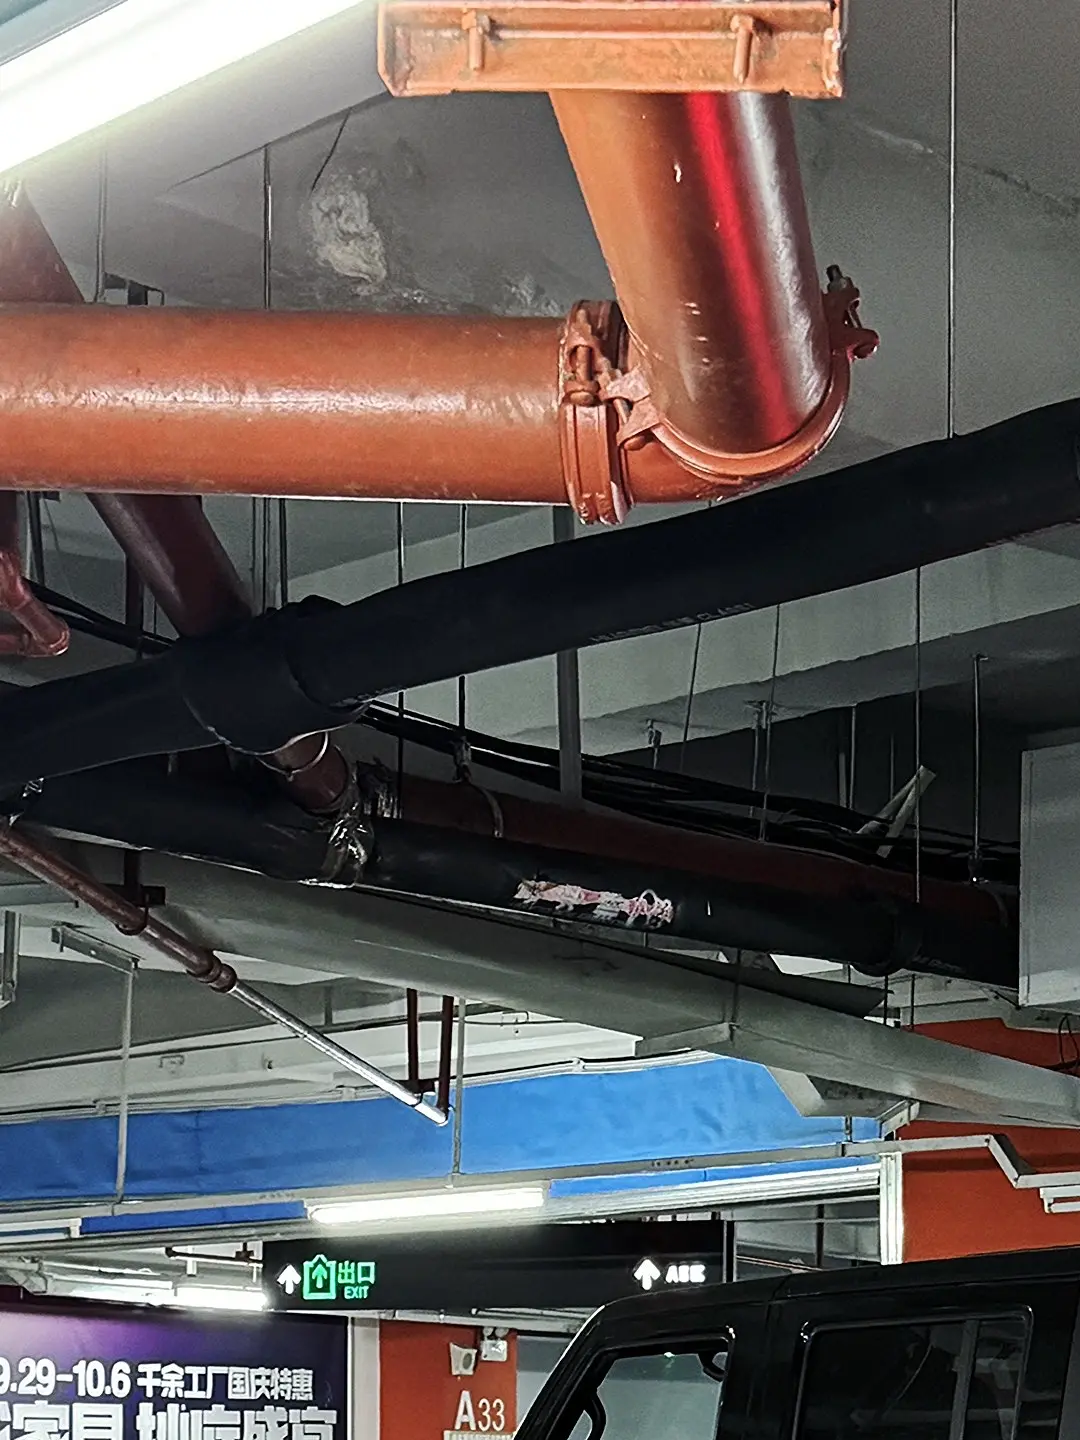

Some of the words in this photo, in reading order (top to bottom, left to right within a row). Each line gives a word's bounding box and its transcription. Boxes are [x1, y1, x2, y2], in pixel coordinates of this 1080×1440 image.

[338, 1261, 375, 1285] 出口
[344, 1285, 369, 1299] EXIT
[137, 1362, 313, 1401] 千余工厂国庆特惠
[454, 1389, 505, 1431] A33
